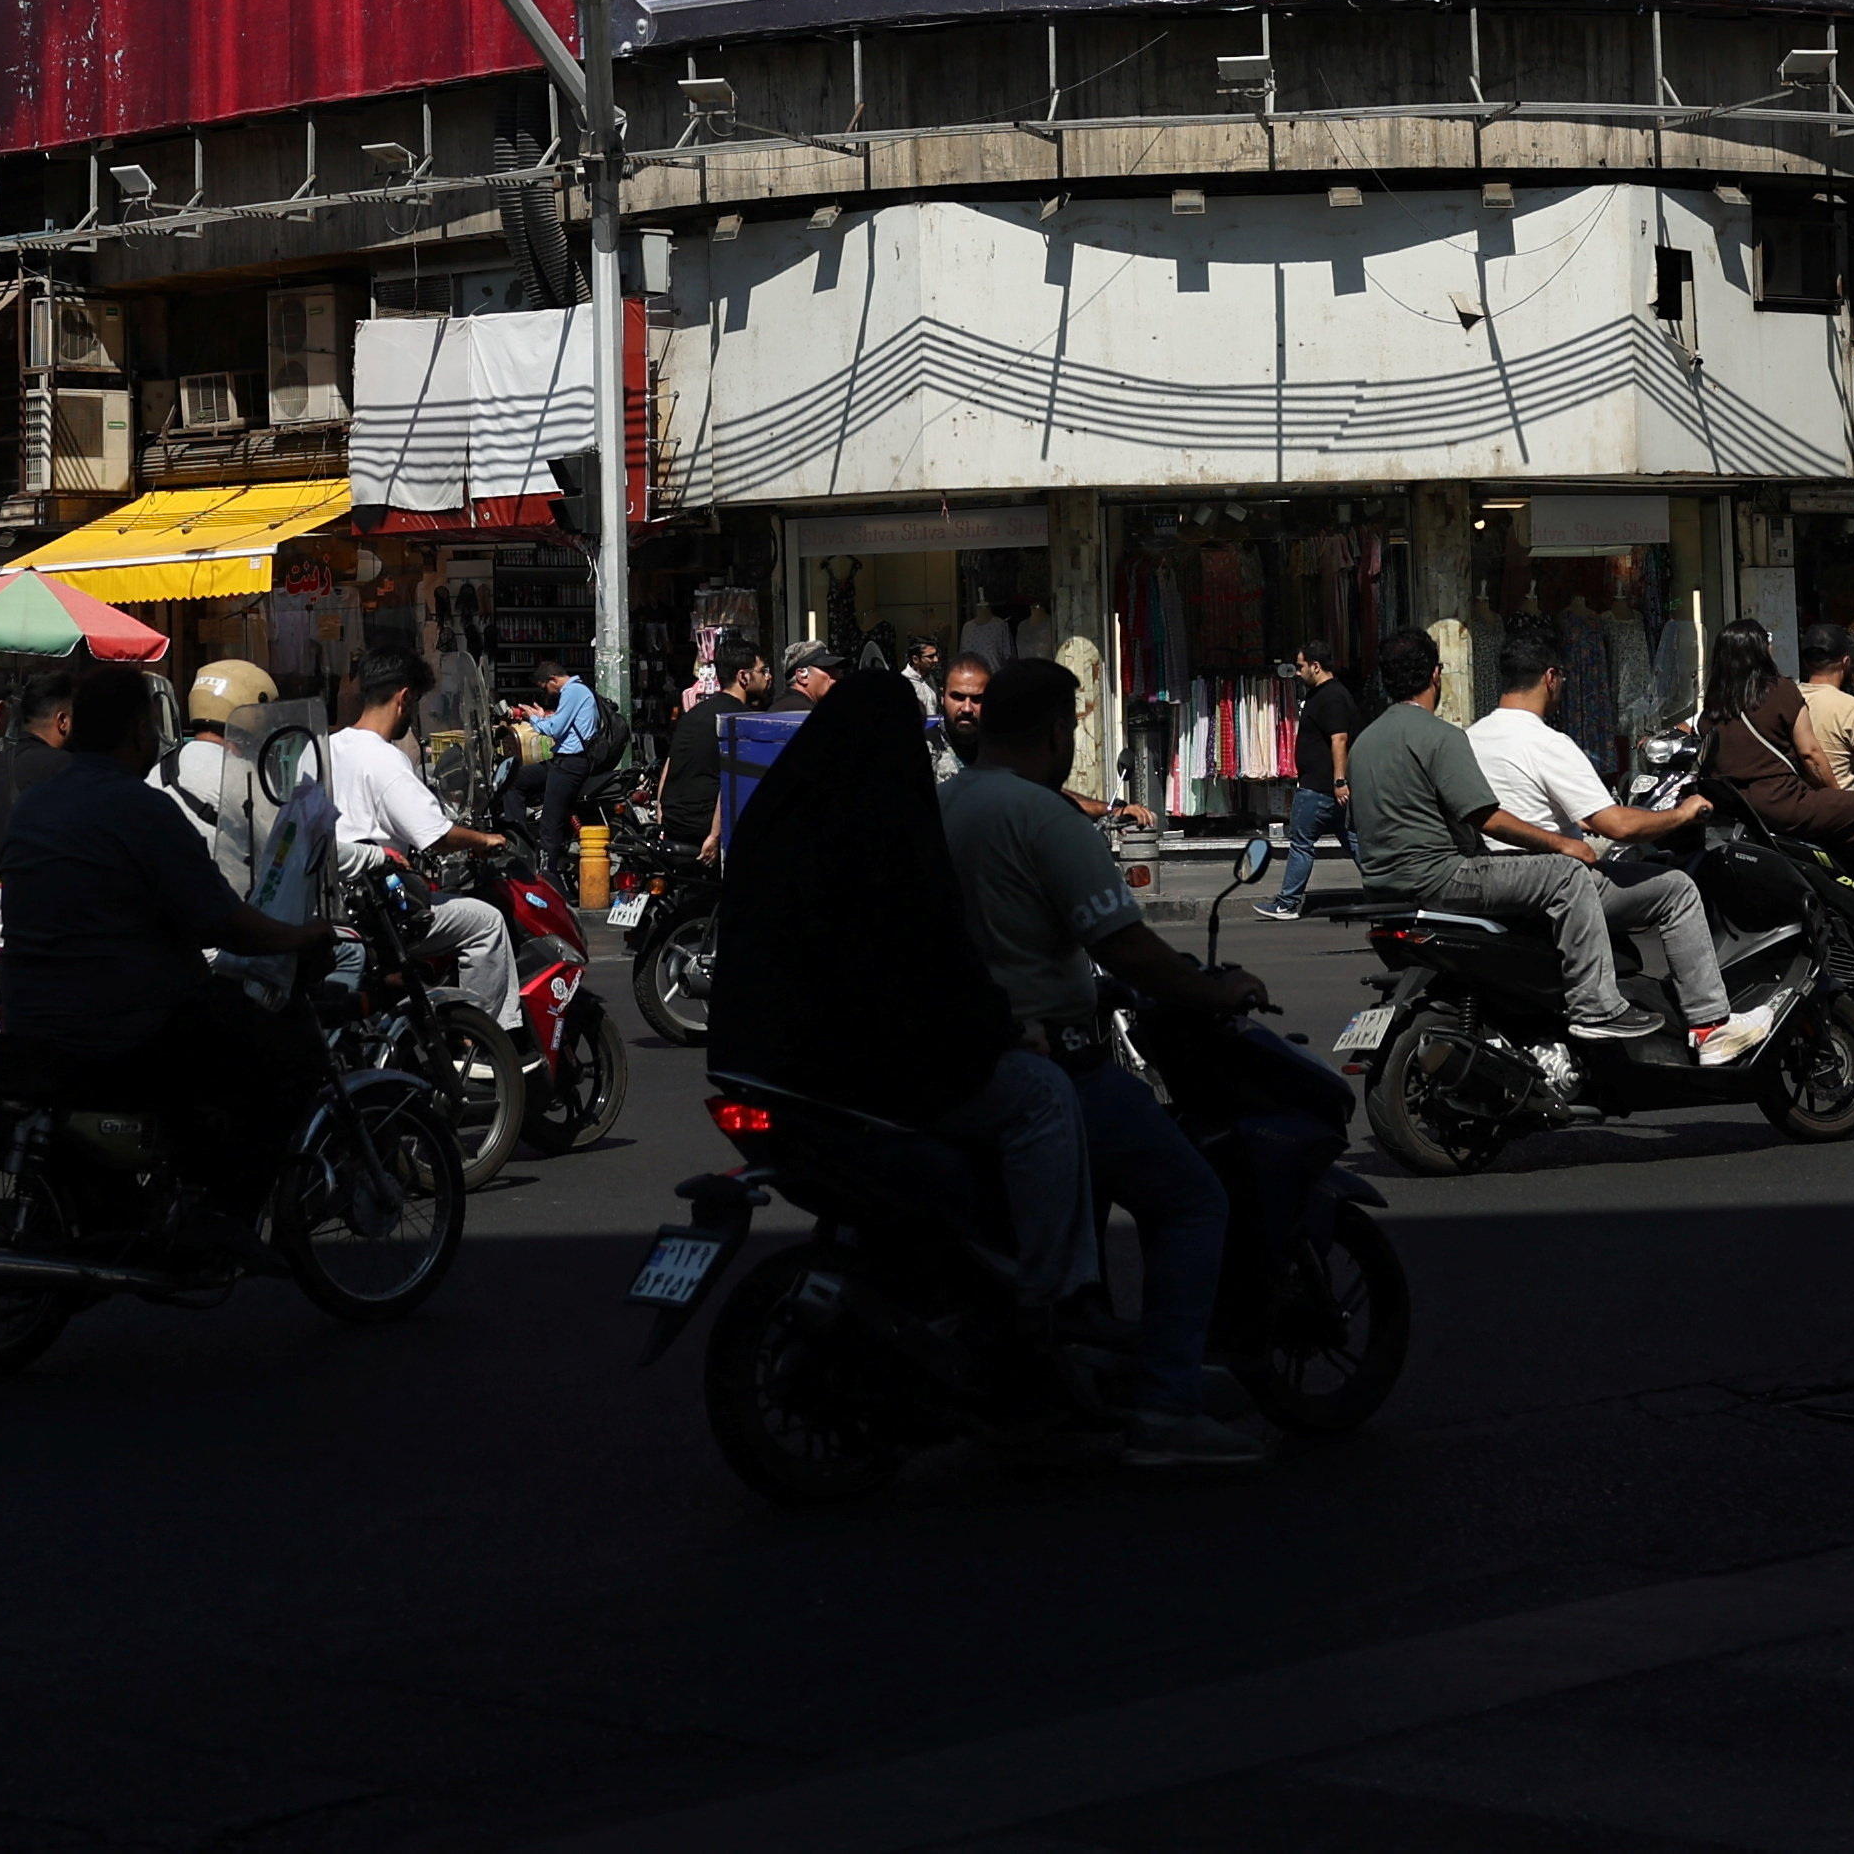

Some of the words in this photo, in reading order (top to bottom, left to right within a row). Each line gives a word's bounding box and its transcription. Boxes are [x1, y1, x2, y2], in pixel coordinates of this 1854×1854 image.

[851, 525, 896, 543] Shiva
[901, 522, 946, 540] Shiva
[953, 519, 999, 539] Shiva
[285, 552, 333, 603] زینت
